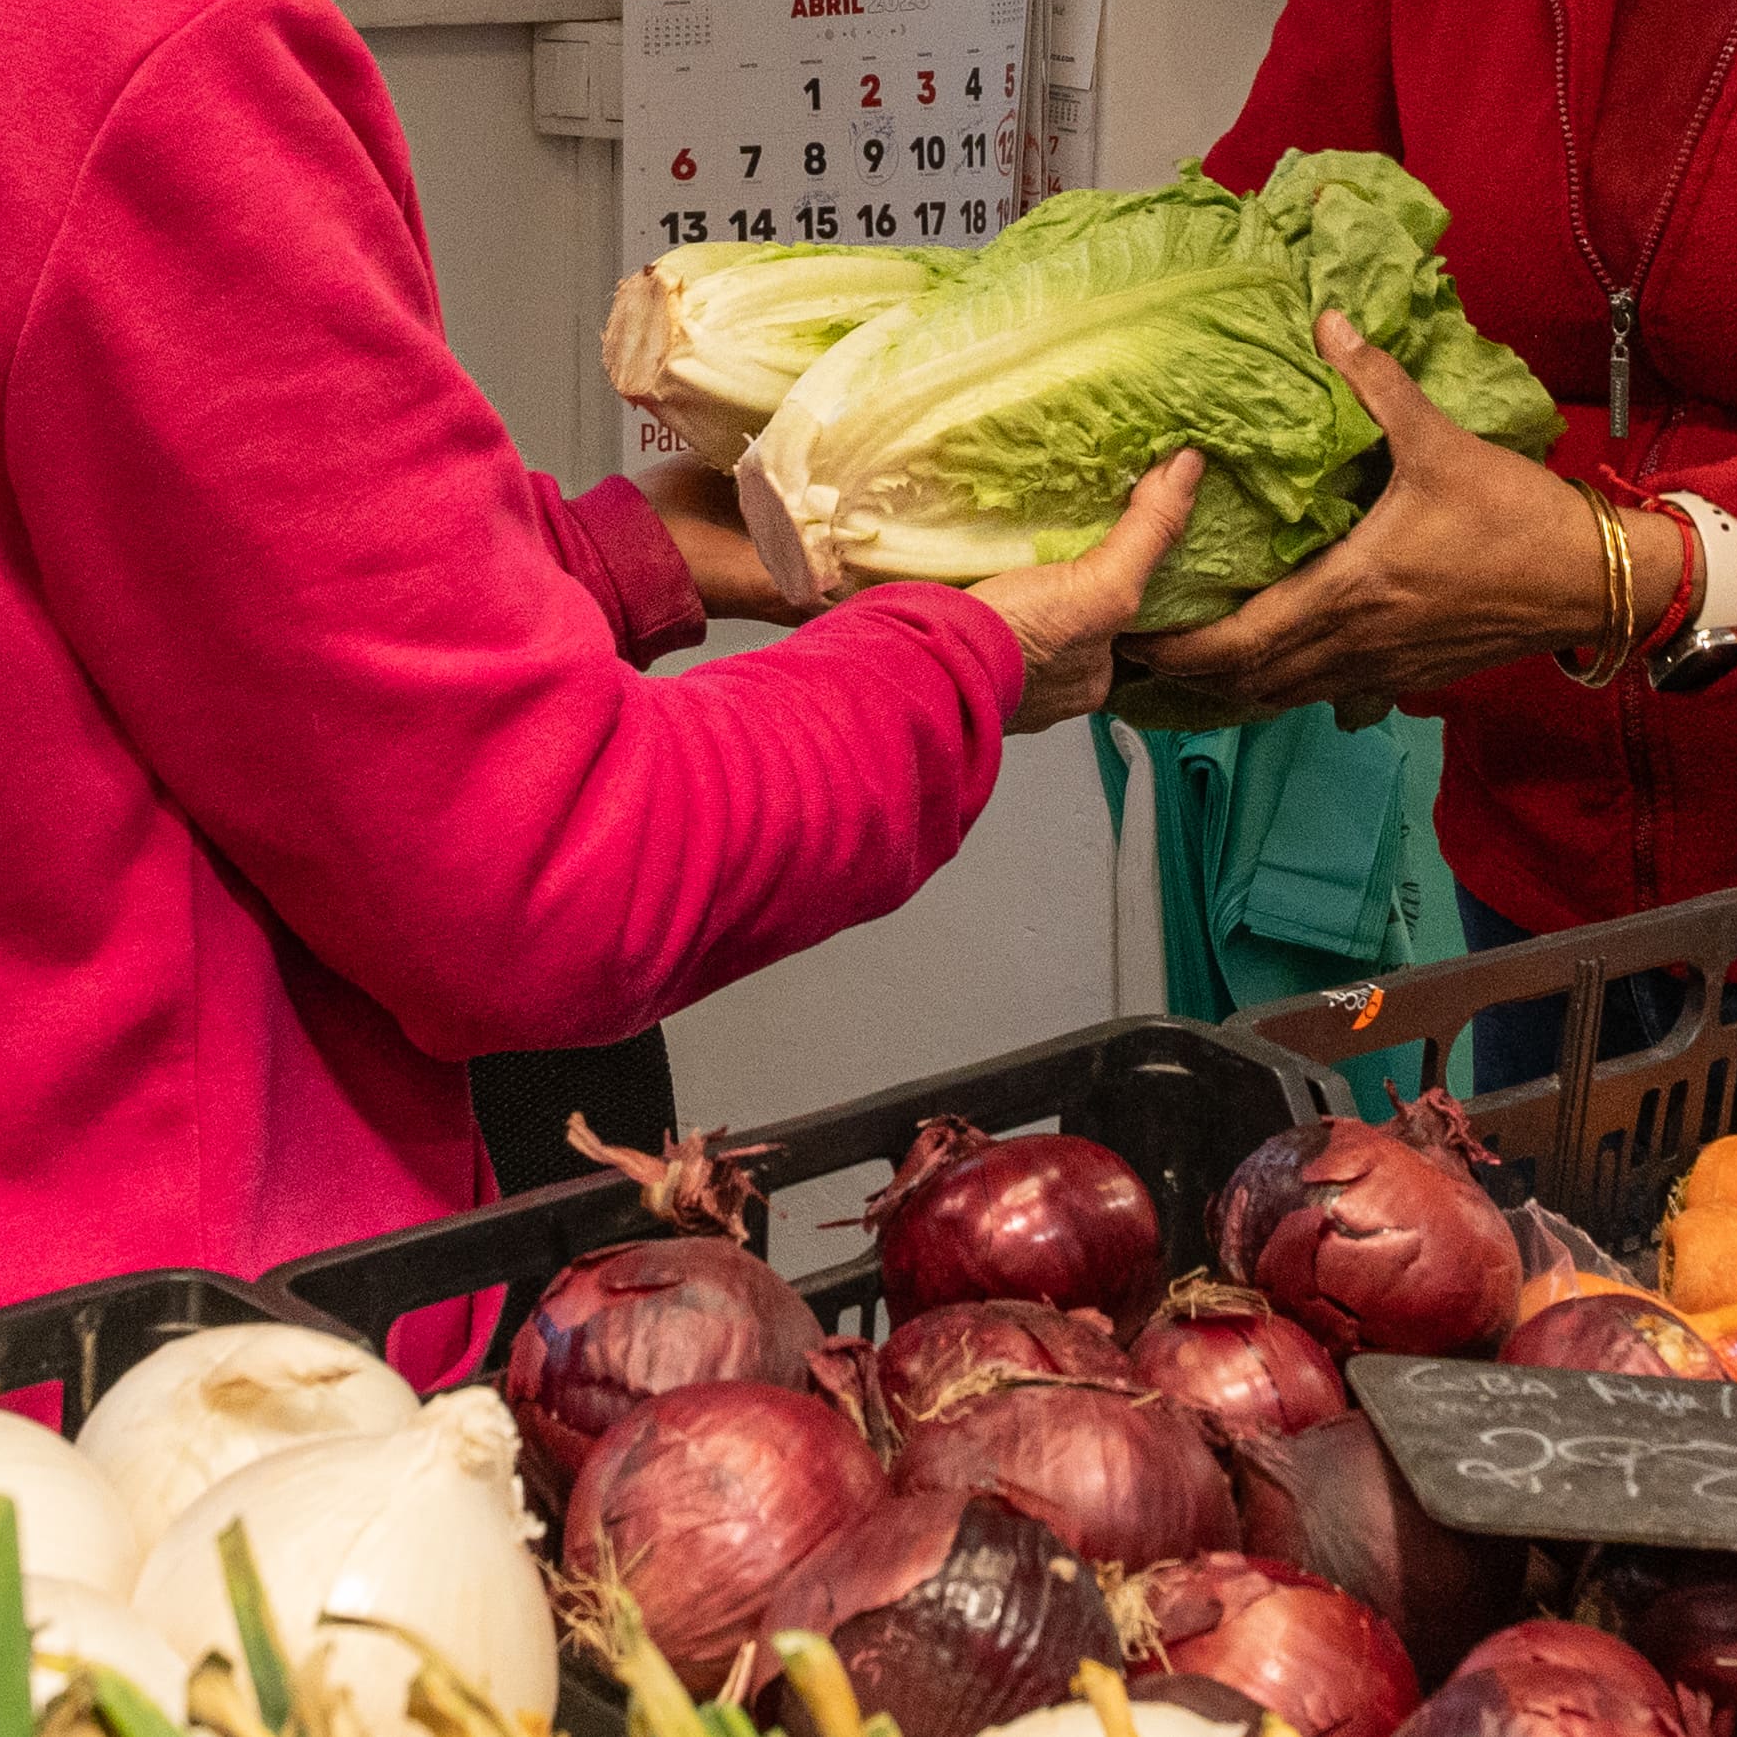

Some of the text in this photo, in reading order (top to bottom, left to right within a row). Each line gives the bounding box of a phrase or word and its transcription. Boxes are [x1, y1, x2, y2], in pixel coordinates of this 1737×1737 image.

[803, 63, 1015, 111] 1 2 3 4 5
[670, 147, 698, 182] 6
[738, 145, 763, 179] 7
[803, 142, 827, 176] 8
[863, 139, 885, 173] 9
[909, 136, 946, 170] 10
[961, 133, 987, 169] 11
[660, 211, 708, 244] 13
[728, 208, 776, 242] 14
[795, 206, 839, 241] 15
[857, 204, 897, 238] 16
[914, 202, 946, 236] 17
[960, 199, 987, 235] 18
